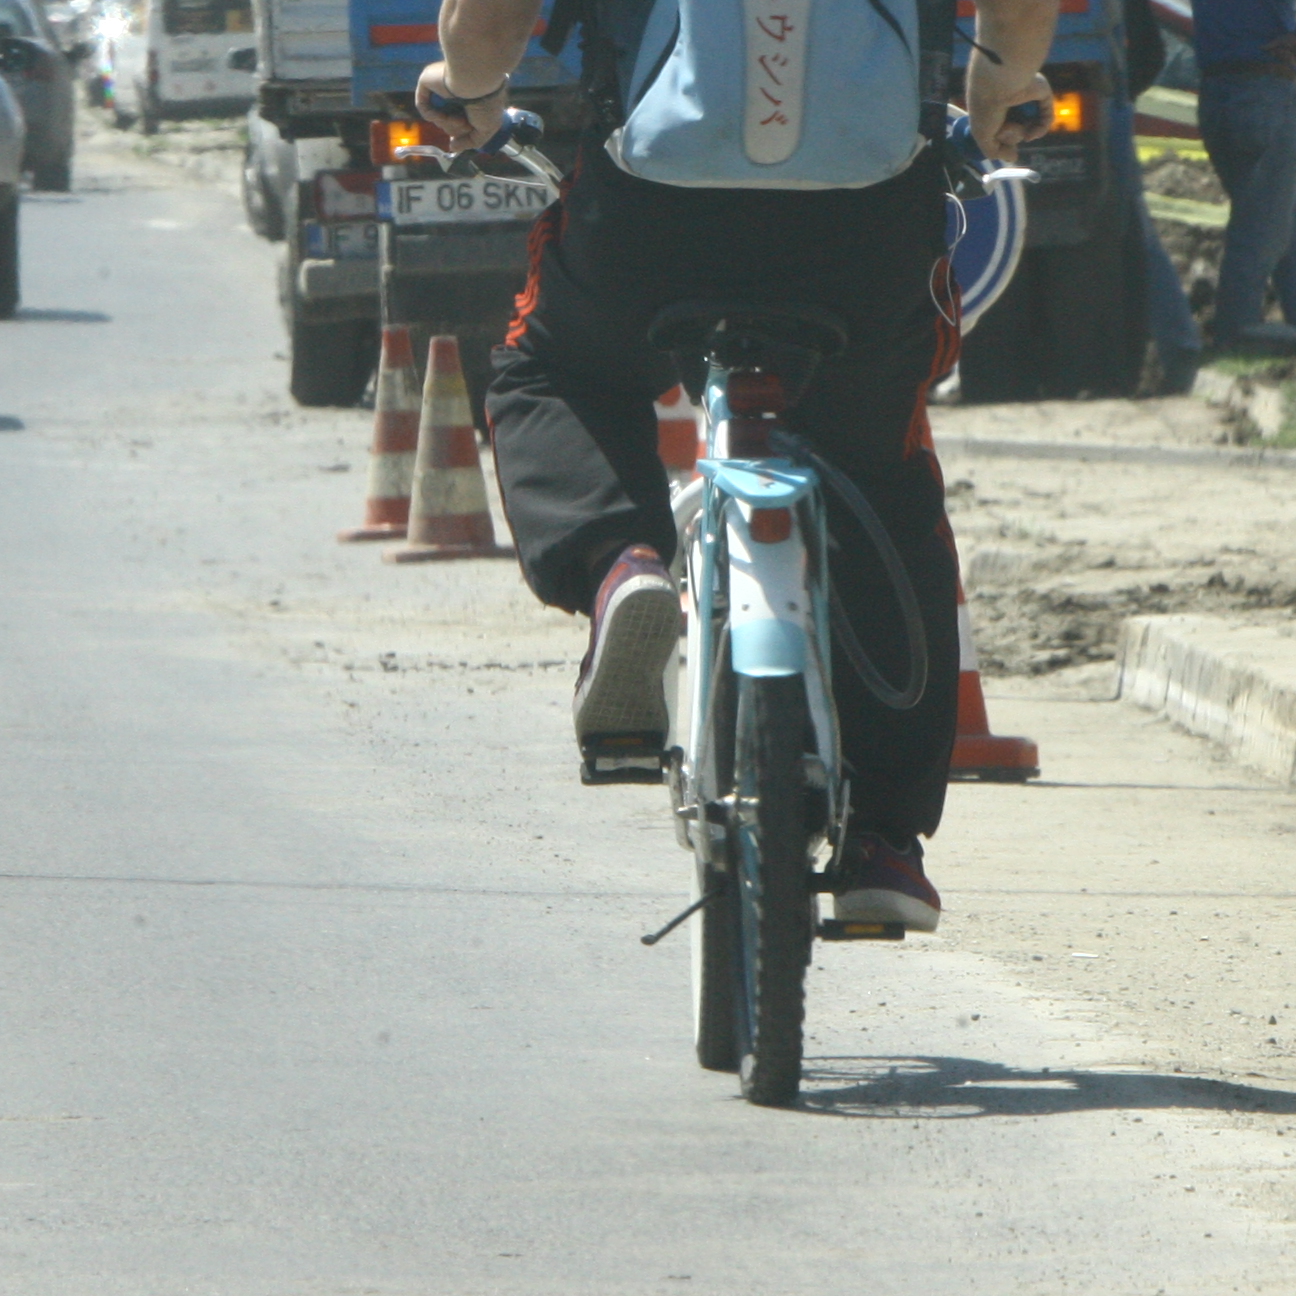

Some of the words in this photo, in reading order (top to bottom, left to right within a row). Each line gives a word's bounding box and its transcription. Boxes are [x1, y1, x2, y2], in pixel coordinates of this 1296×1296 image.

[397, 183, 425, 215] IF
[436, 182, 475, 212] 06
[482, 181, 549, 210] SKN
